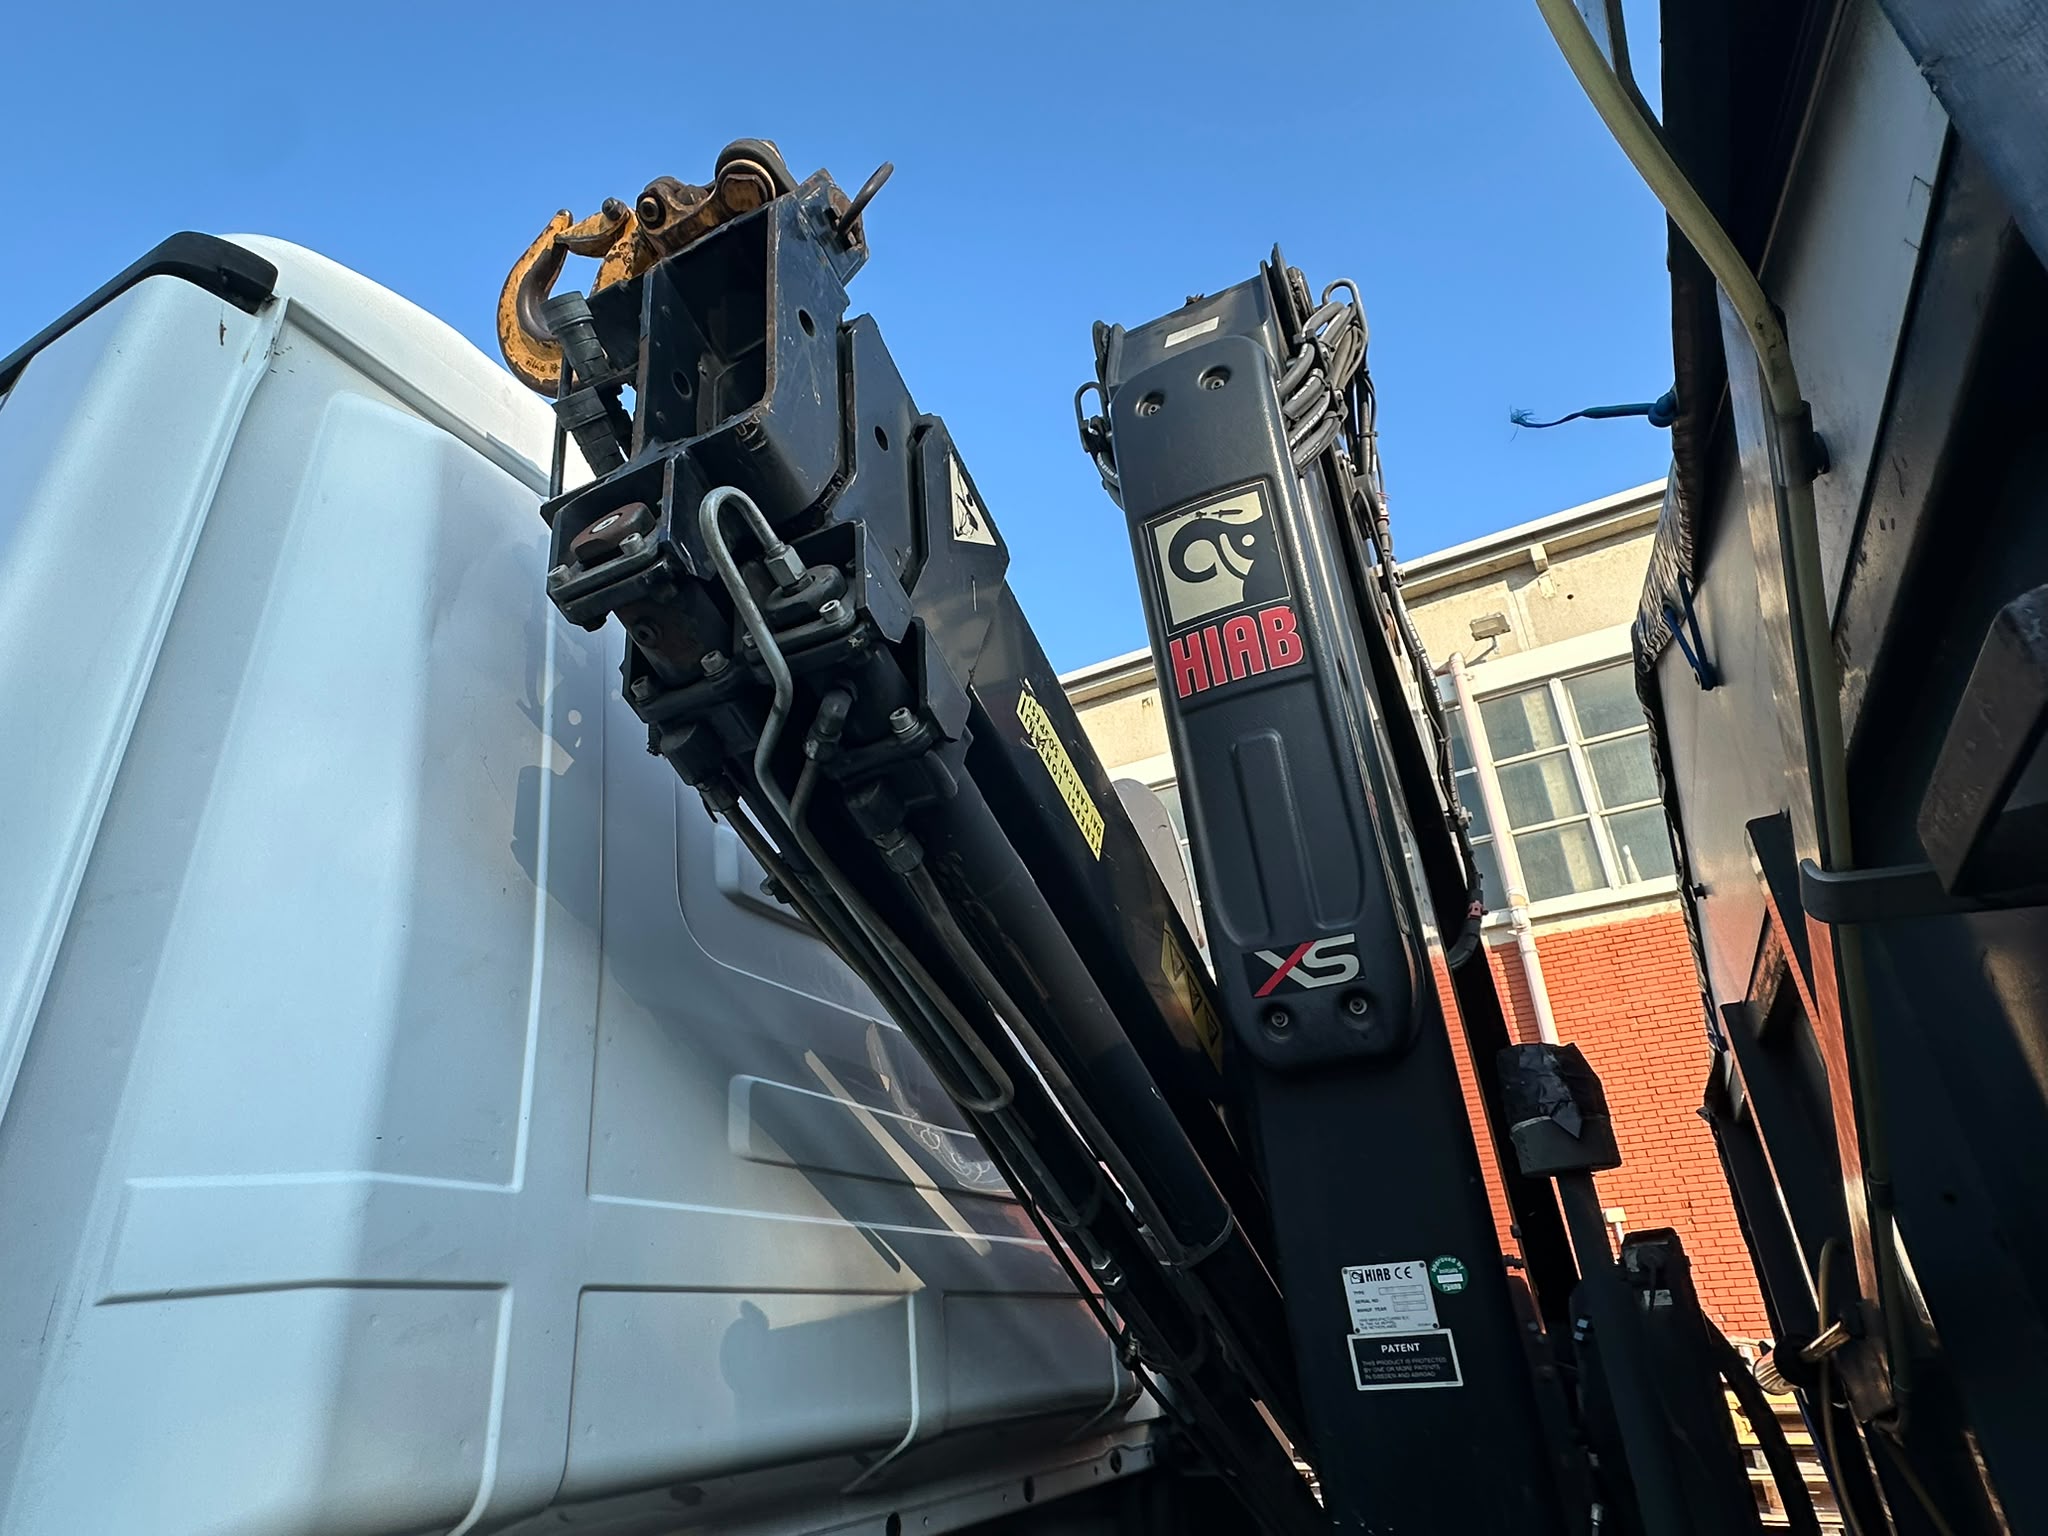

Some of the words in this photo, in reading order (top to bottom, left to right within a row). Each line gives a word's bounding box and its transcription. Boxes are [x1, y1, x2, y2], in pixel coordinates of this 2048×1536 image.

[1169, 605, 1304, 699] HIAB
[1061, 758, 1089, 814] CARICHI
[1068, 792, 1101, 853] TENERSI
[1090, 814, 1102, 837] DAI
[1254, 932, 1360, 998] XS
[1364, 1268, 1391, 1283] HIAB
[1381, 1342, 1420, 1353] PATENT
